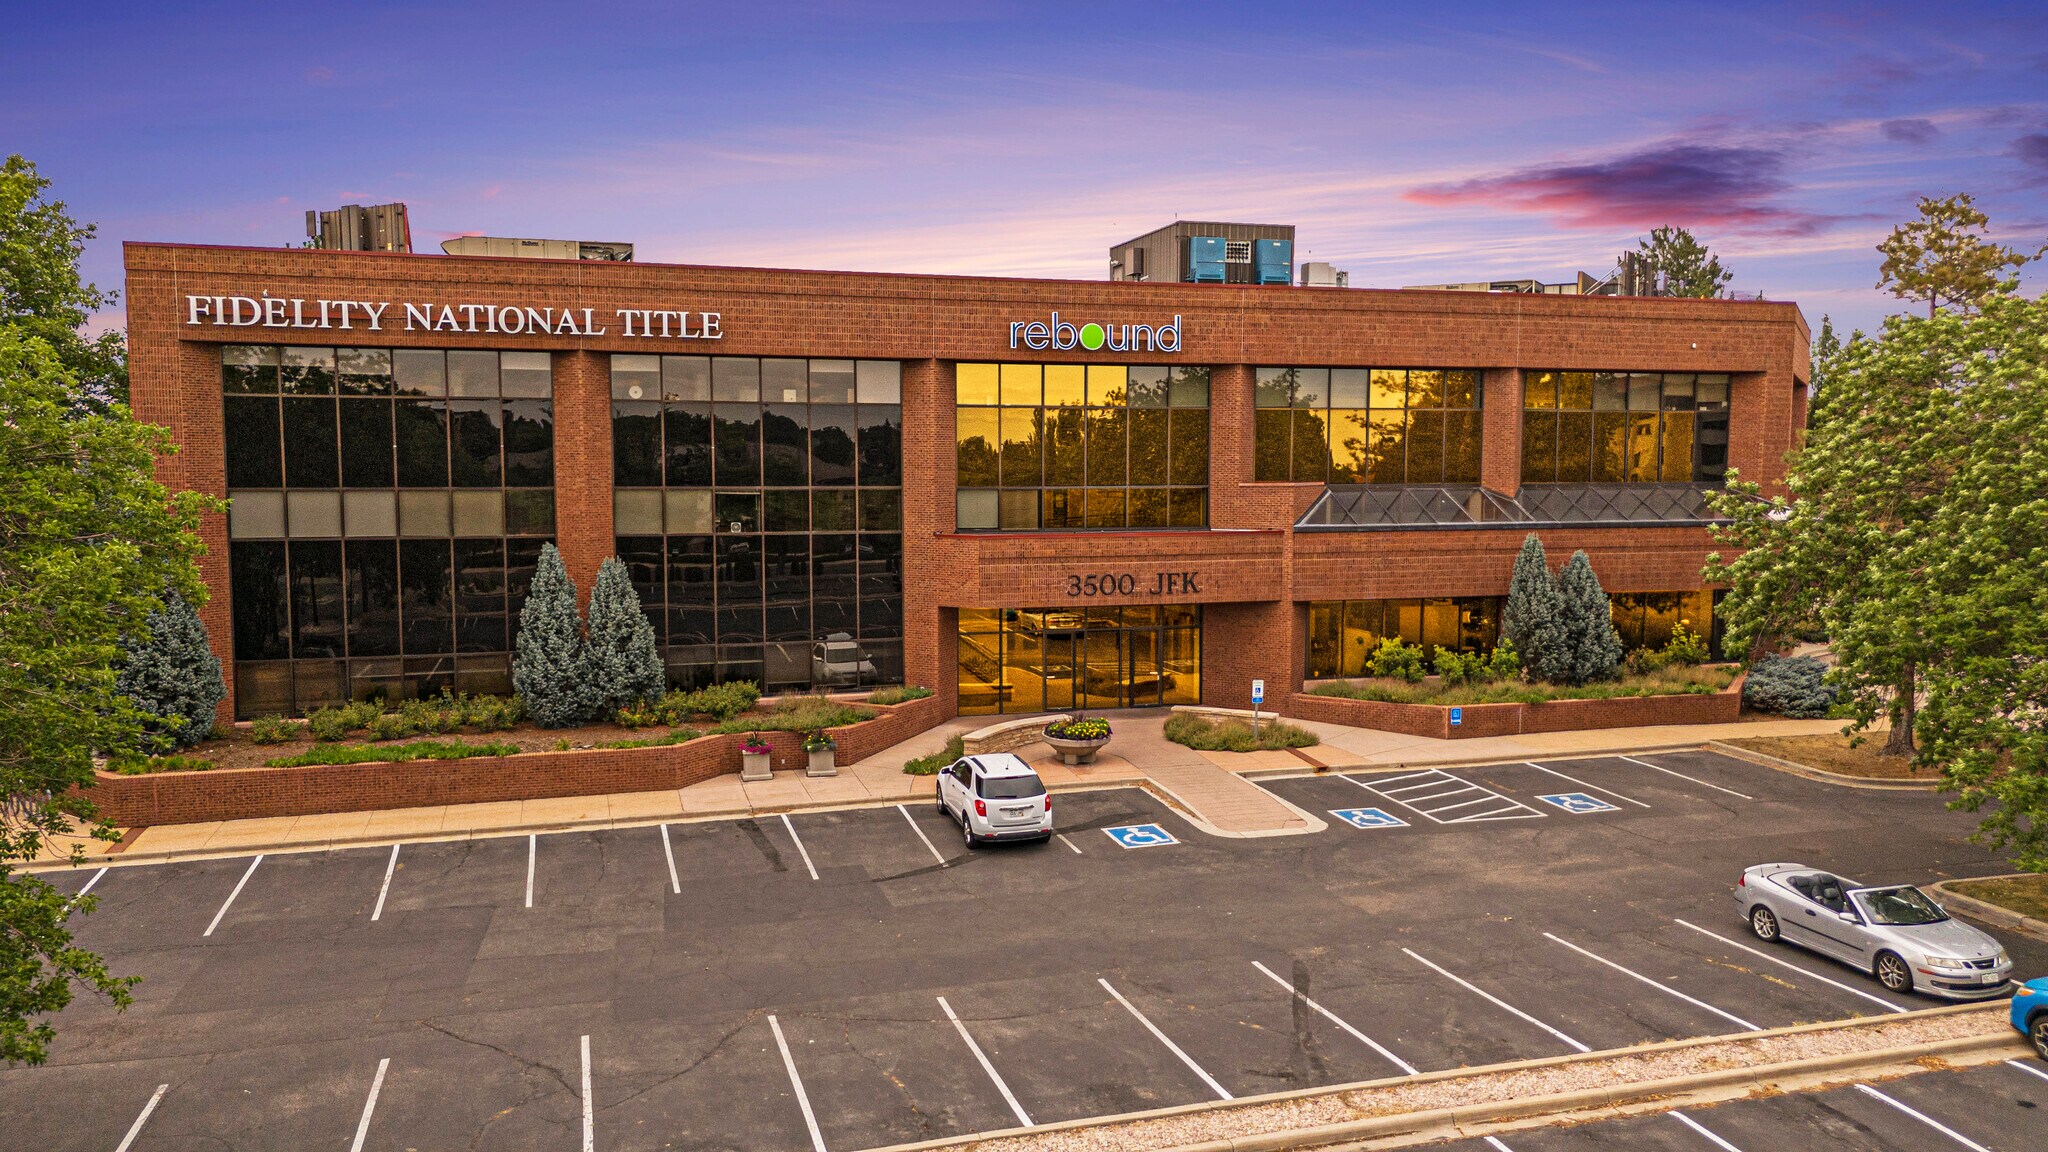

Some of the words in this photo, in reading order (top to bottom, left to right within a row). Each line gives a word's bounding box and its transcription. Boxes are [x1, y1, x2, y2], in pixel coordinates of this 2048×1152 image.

[185, 295, 390, 330] FIDELITY
[403, 303, 606, 336] NATIONAL
[616, 309, 724, 339] TITLE
[1010, 312, 1182, 352] rebound
[1067, 573, 1135, 597] 3500
[1149, 571, 1201, 595] JFK
